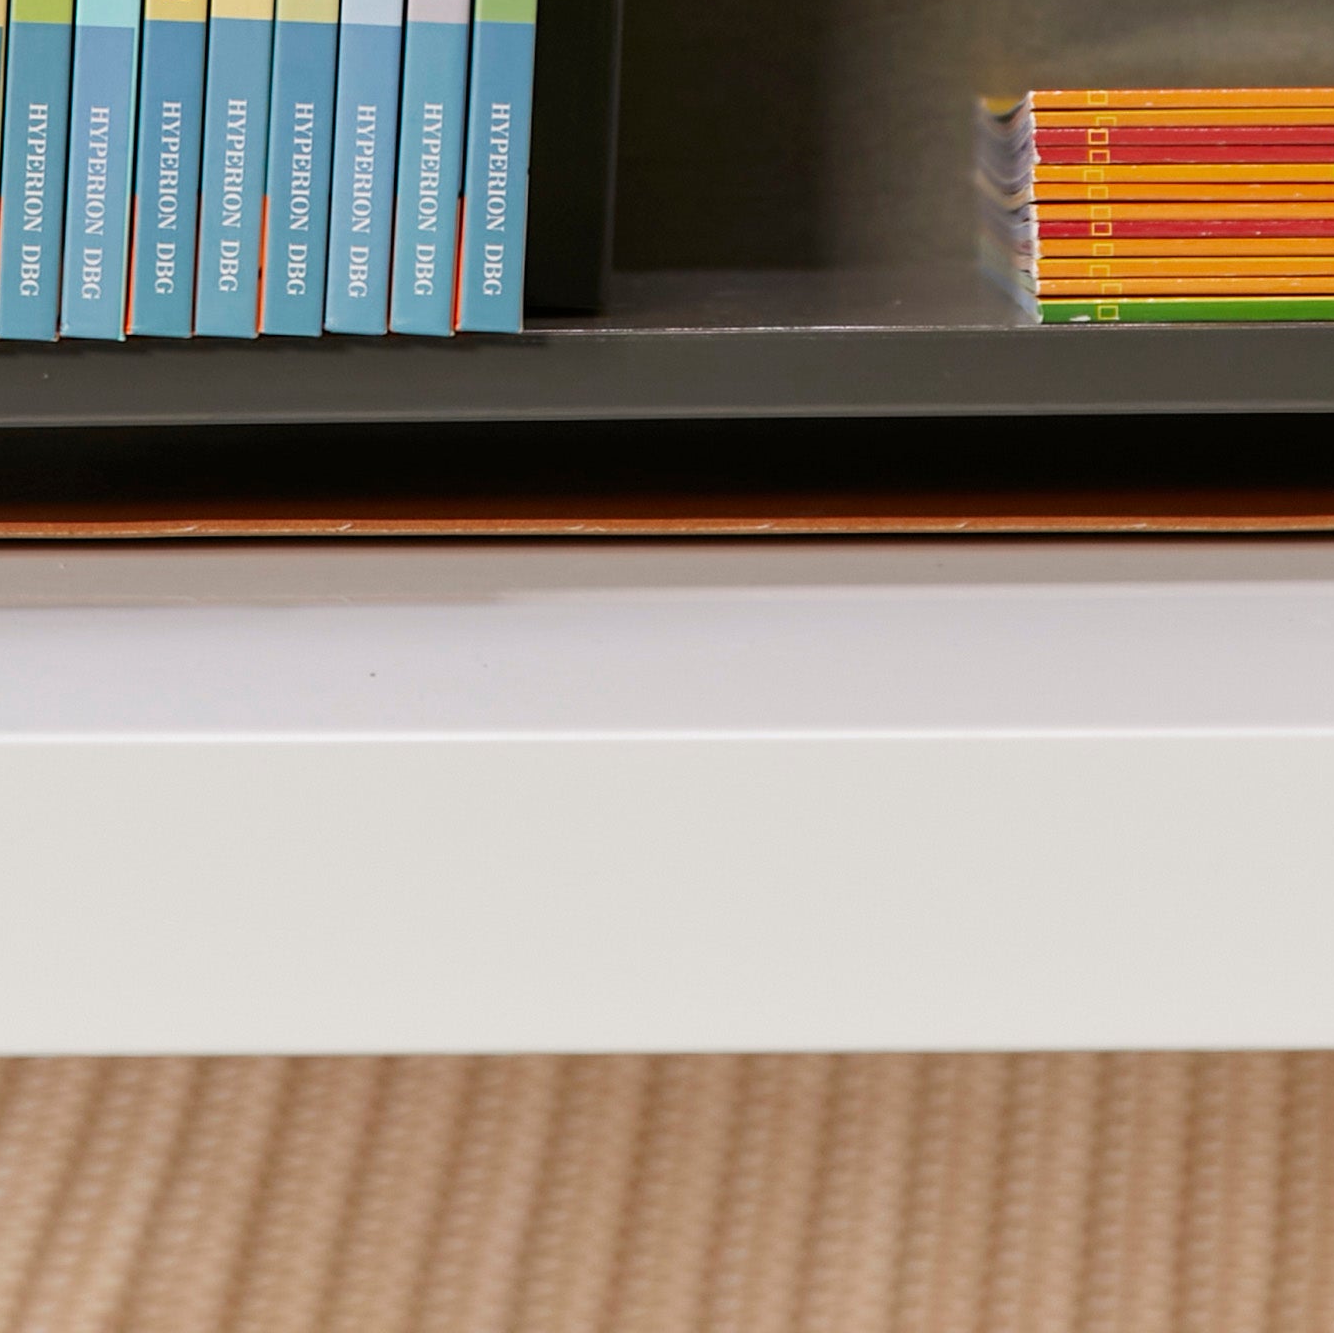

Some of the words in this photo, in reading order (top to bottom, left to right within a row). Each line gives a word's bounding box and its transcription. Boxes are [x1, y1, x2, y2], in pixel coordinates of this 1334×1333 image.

[221, 98, 248, 228] HYPERION
[417, 102, 444, 233] HYPERION
[218, 239, 241, 292] DBG
[413, 243, 436, 296] DBG
